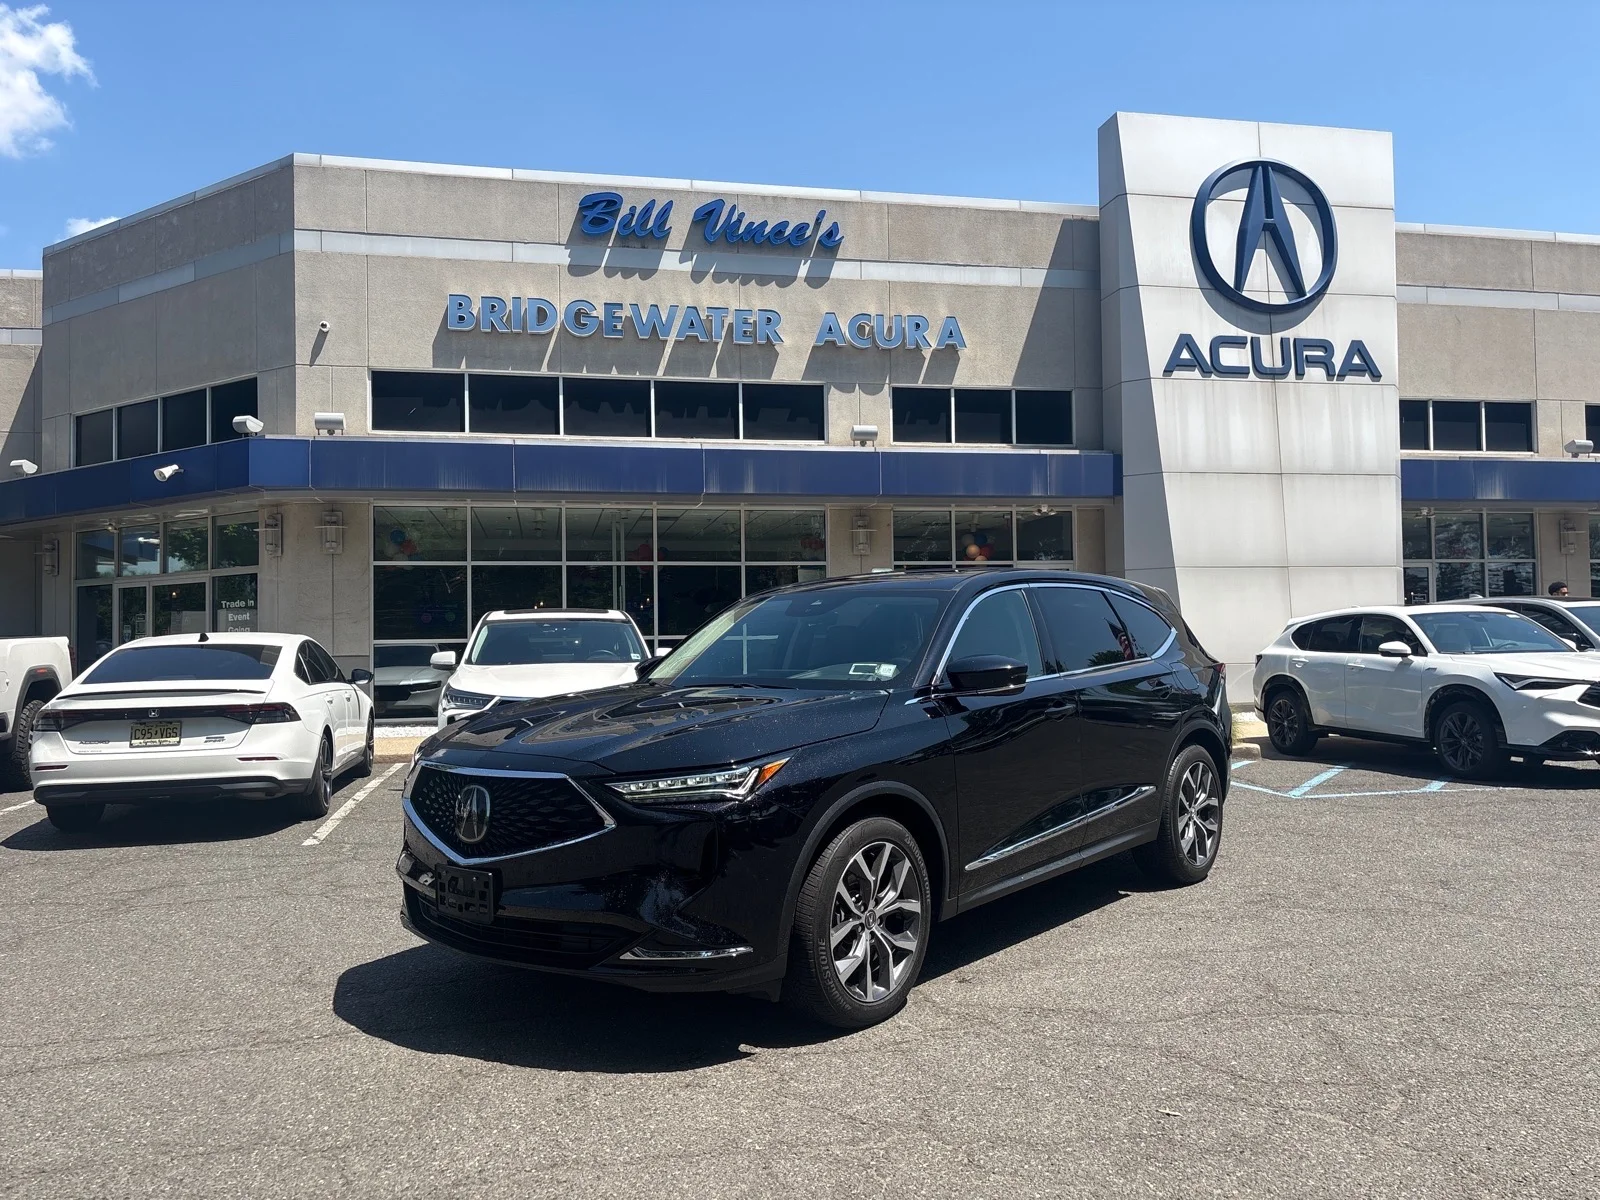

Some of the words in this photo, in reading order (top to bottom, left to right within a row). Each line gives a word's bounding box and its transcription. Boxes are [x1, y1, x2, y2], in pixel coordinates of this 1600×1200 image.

[578, 191, 674, 240] Bill
[692, 198, 845, 247] Vince's
[446, 293, 784, 346] BRIDGEWATER
[814, 312, 968, 350] ACURA
[1162, 333, 1382, 381] ACURA
[221, 600, 246, 608] Trade
[228, 612, 250, 621] Event
